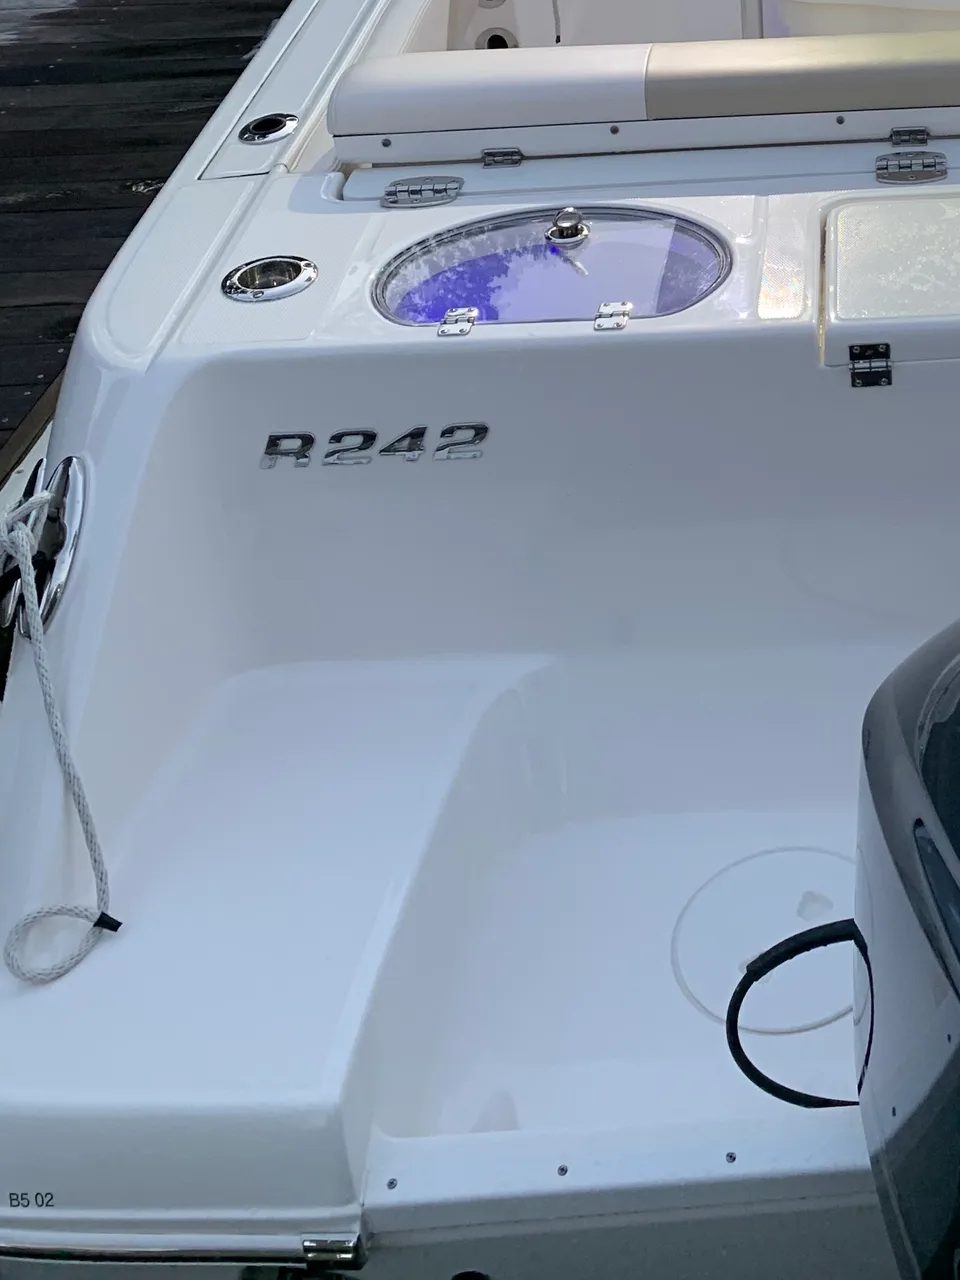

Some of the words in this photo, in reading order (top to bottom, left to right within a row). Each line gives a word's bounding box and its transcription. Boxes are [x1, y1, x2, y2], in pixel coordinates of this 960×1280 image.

[259, 421, 490, 470] R242
[9, 1192, 30, 1208] B5
[34, 1192, 55, 1208] 02
